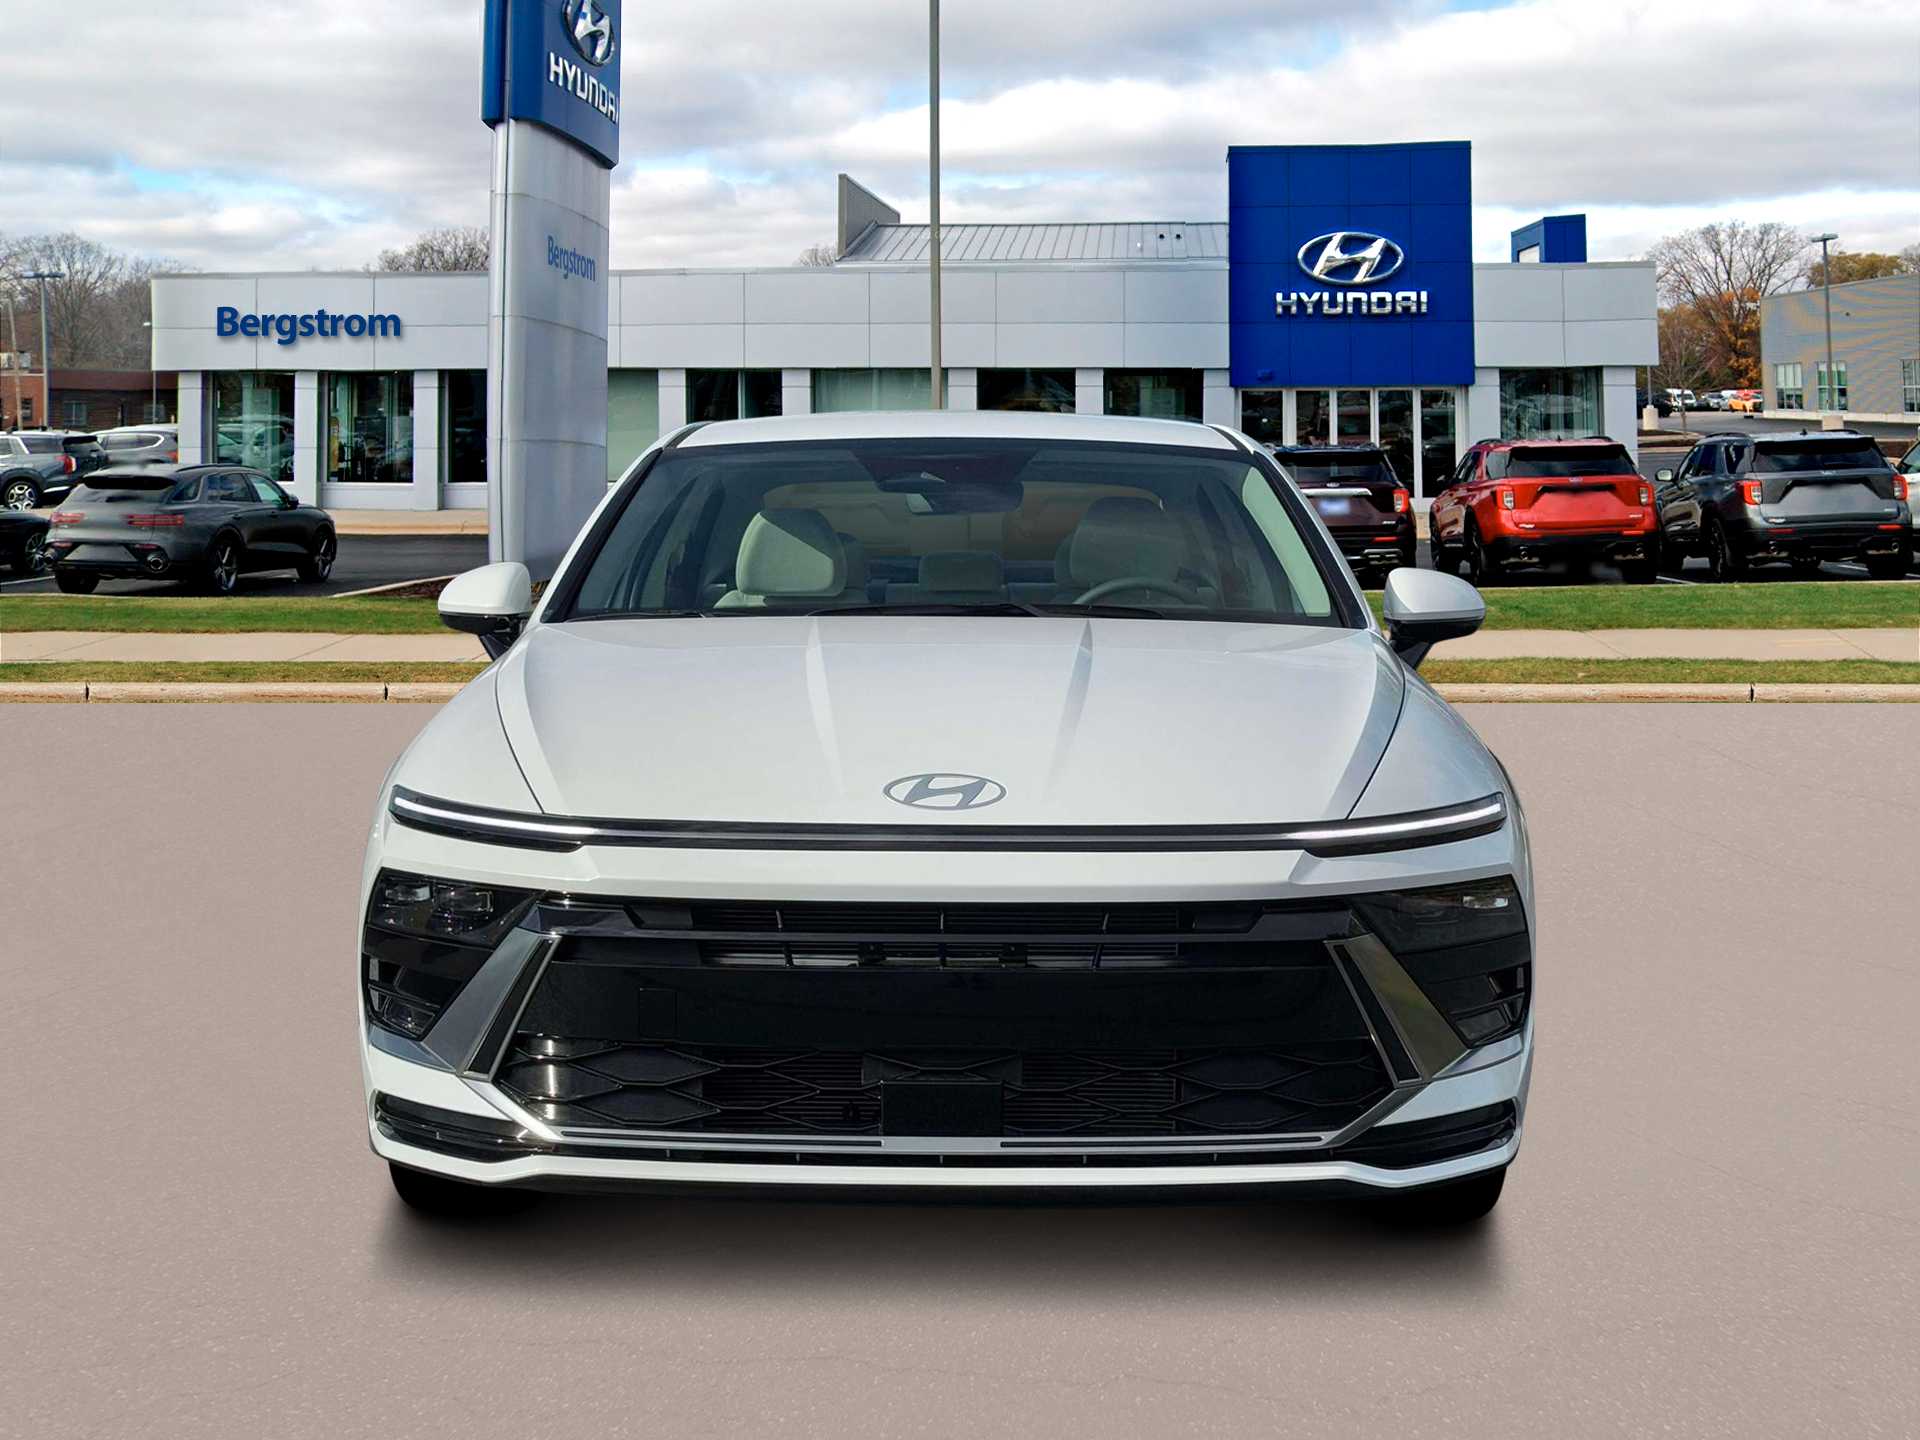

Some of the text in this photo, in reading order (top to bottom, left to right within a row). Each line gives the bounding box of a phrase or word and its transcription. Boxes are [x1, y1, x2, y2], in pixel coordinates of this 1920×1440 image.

[549, 52, 619, 123] HYUNDAI
[547, 235, 596, 281] Bergstrom
[1275, 290, 1428, 315] HYUNDAI
[216, 306, 402, 346] Bergstrom
